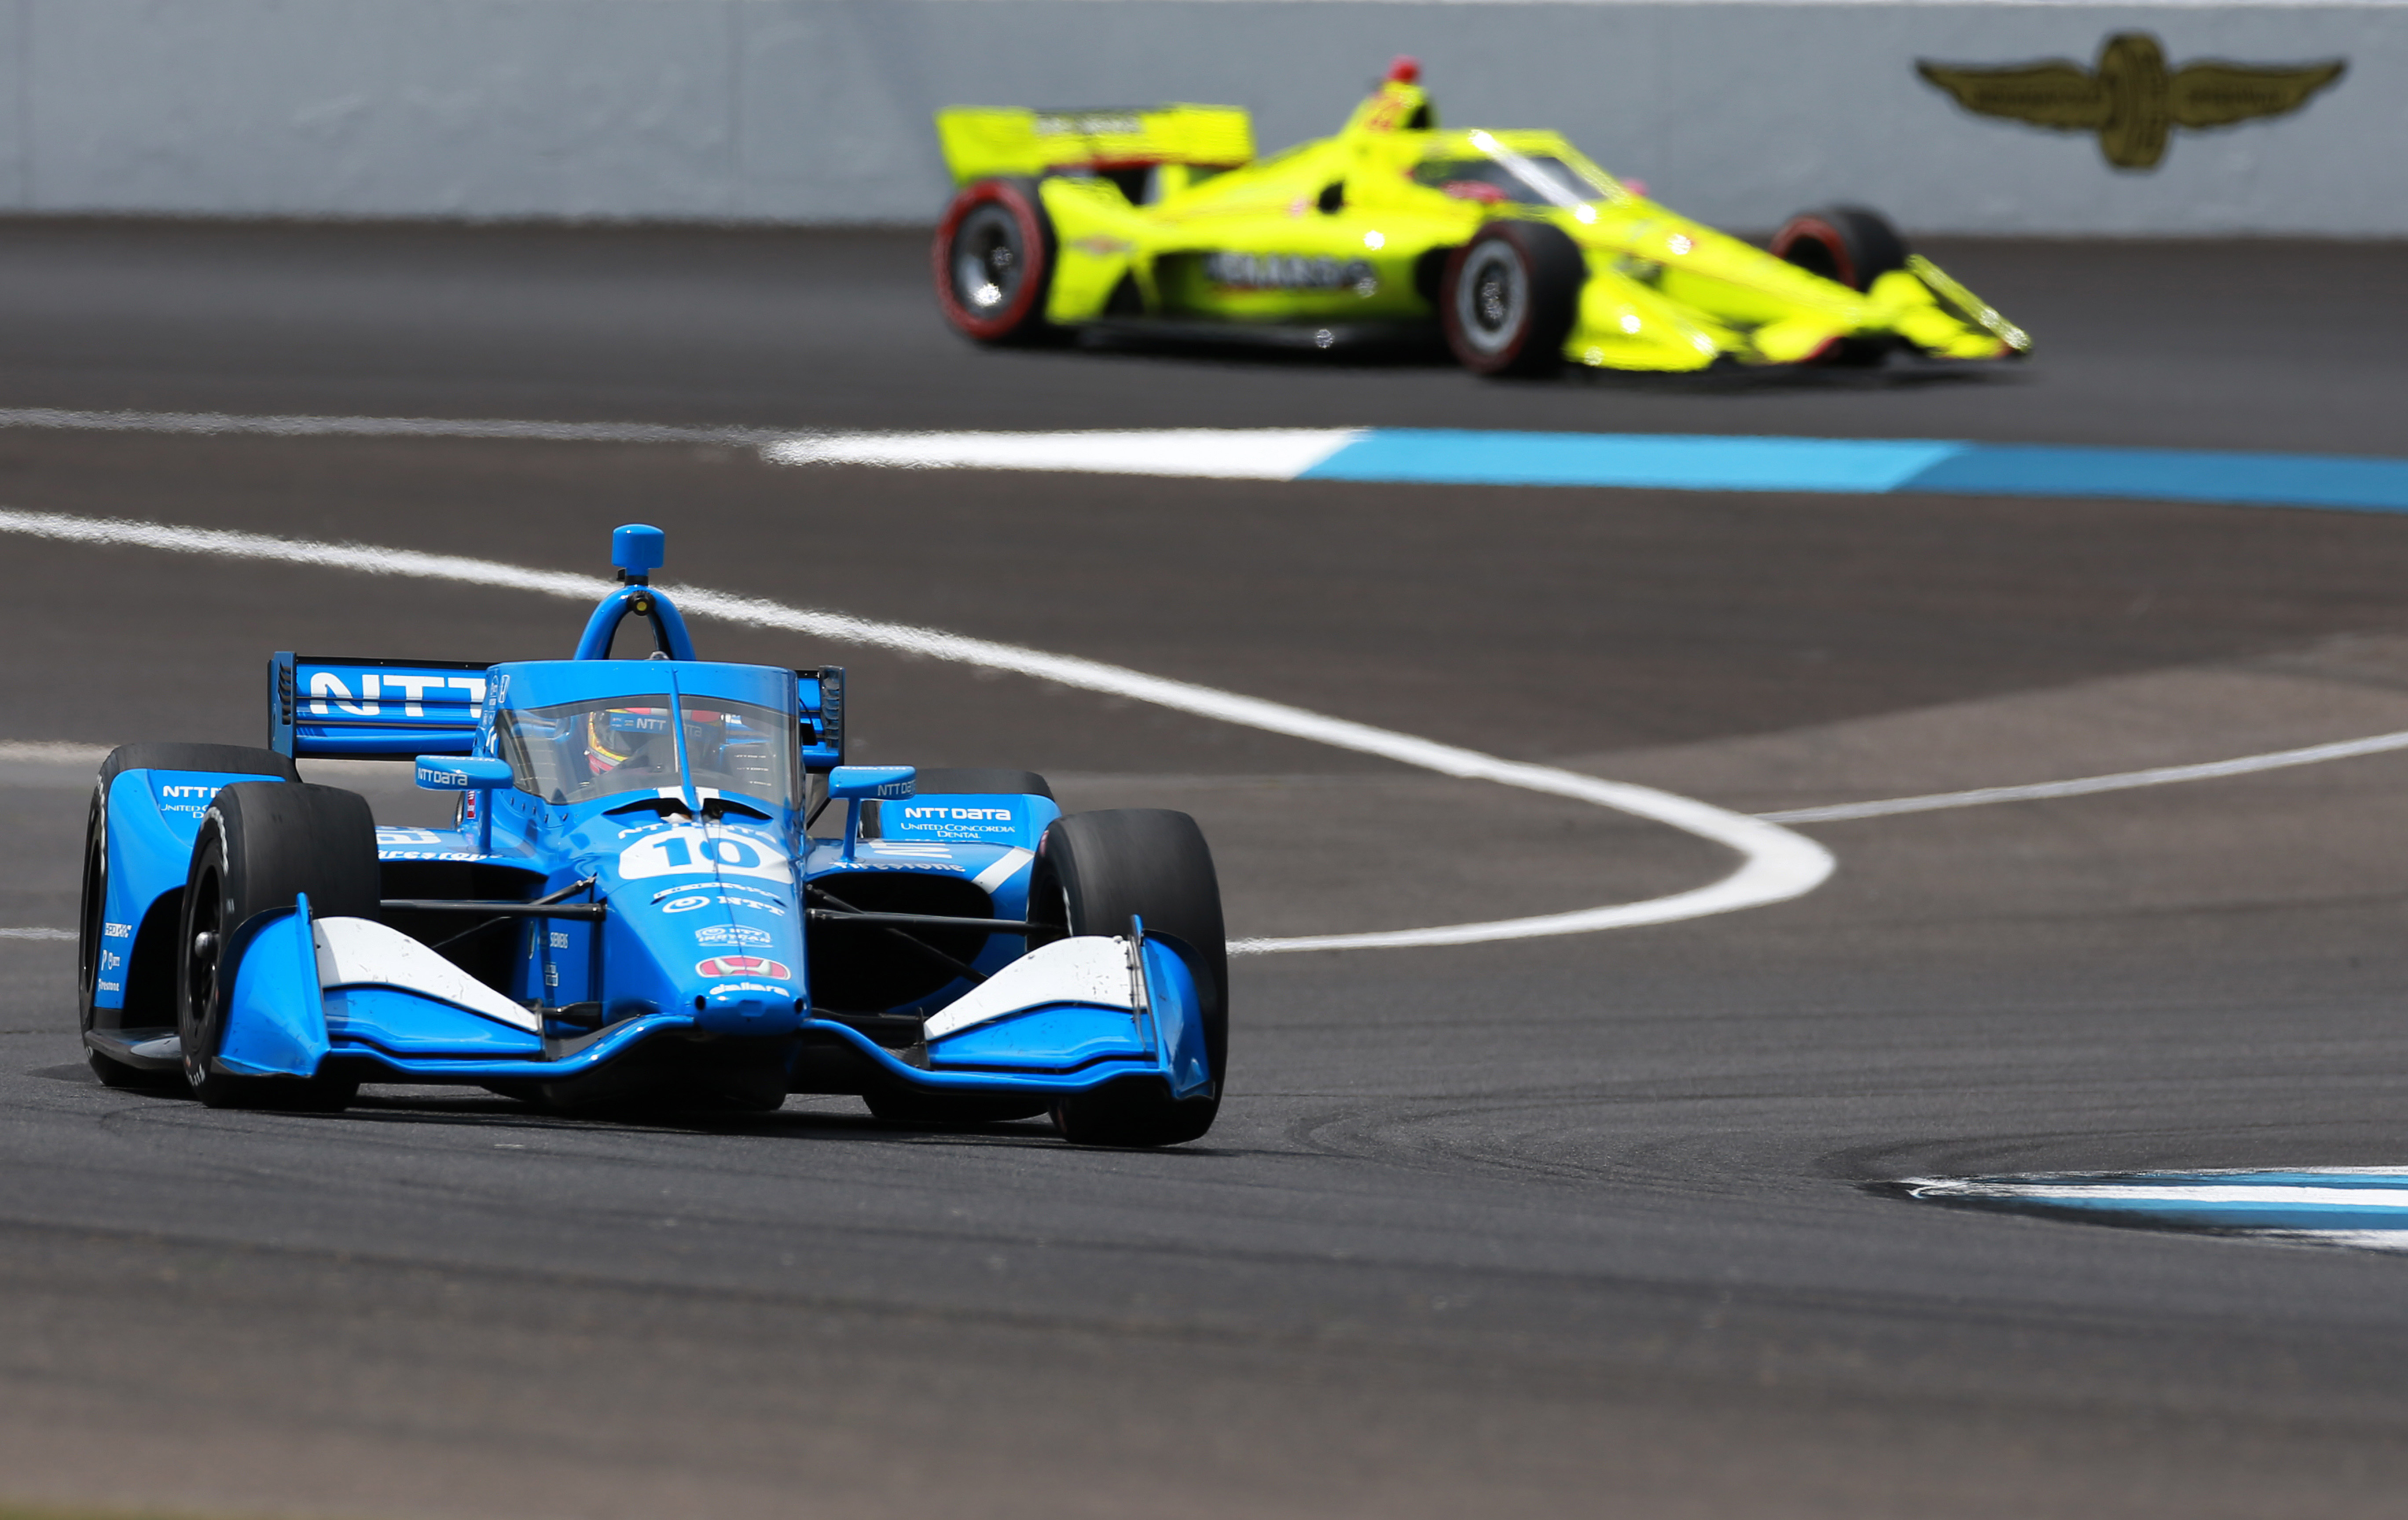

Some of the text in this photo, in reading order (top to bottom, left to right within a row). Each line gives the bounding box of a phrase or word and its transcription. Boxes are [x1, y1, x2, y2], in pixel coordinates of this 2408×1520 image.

[310, 673, 487, 718] NTT
[637, 718, 666, 731] NTT
[418, 767, 433, 782] NTT
[163, 785, 208, 798] NTT
[878, 783, 900, 796] NTT
[905, 807, 948, 818] NTT
[945, 824, 1015, 832] CONCORDIA
[653, 837, 760, 868] 10
[709, 982, 789, 997] dallara
